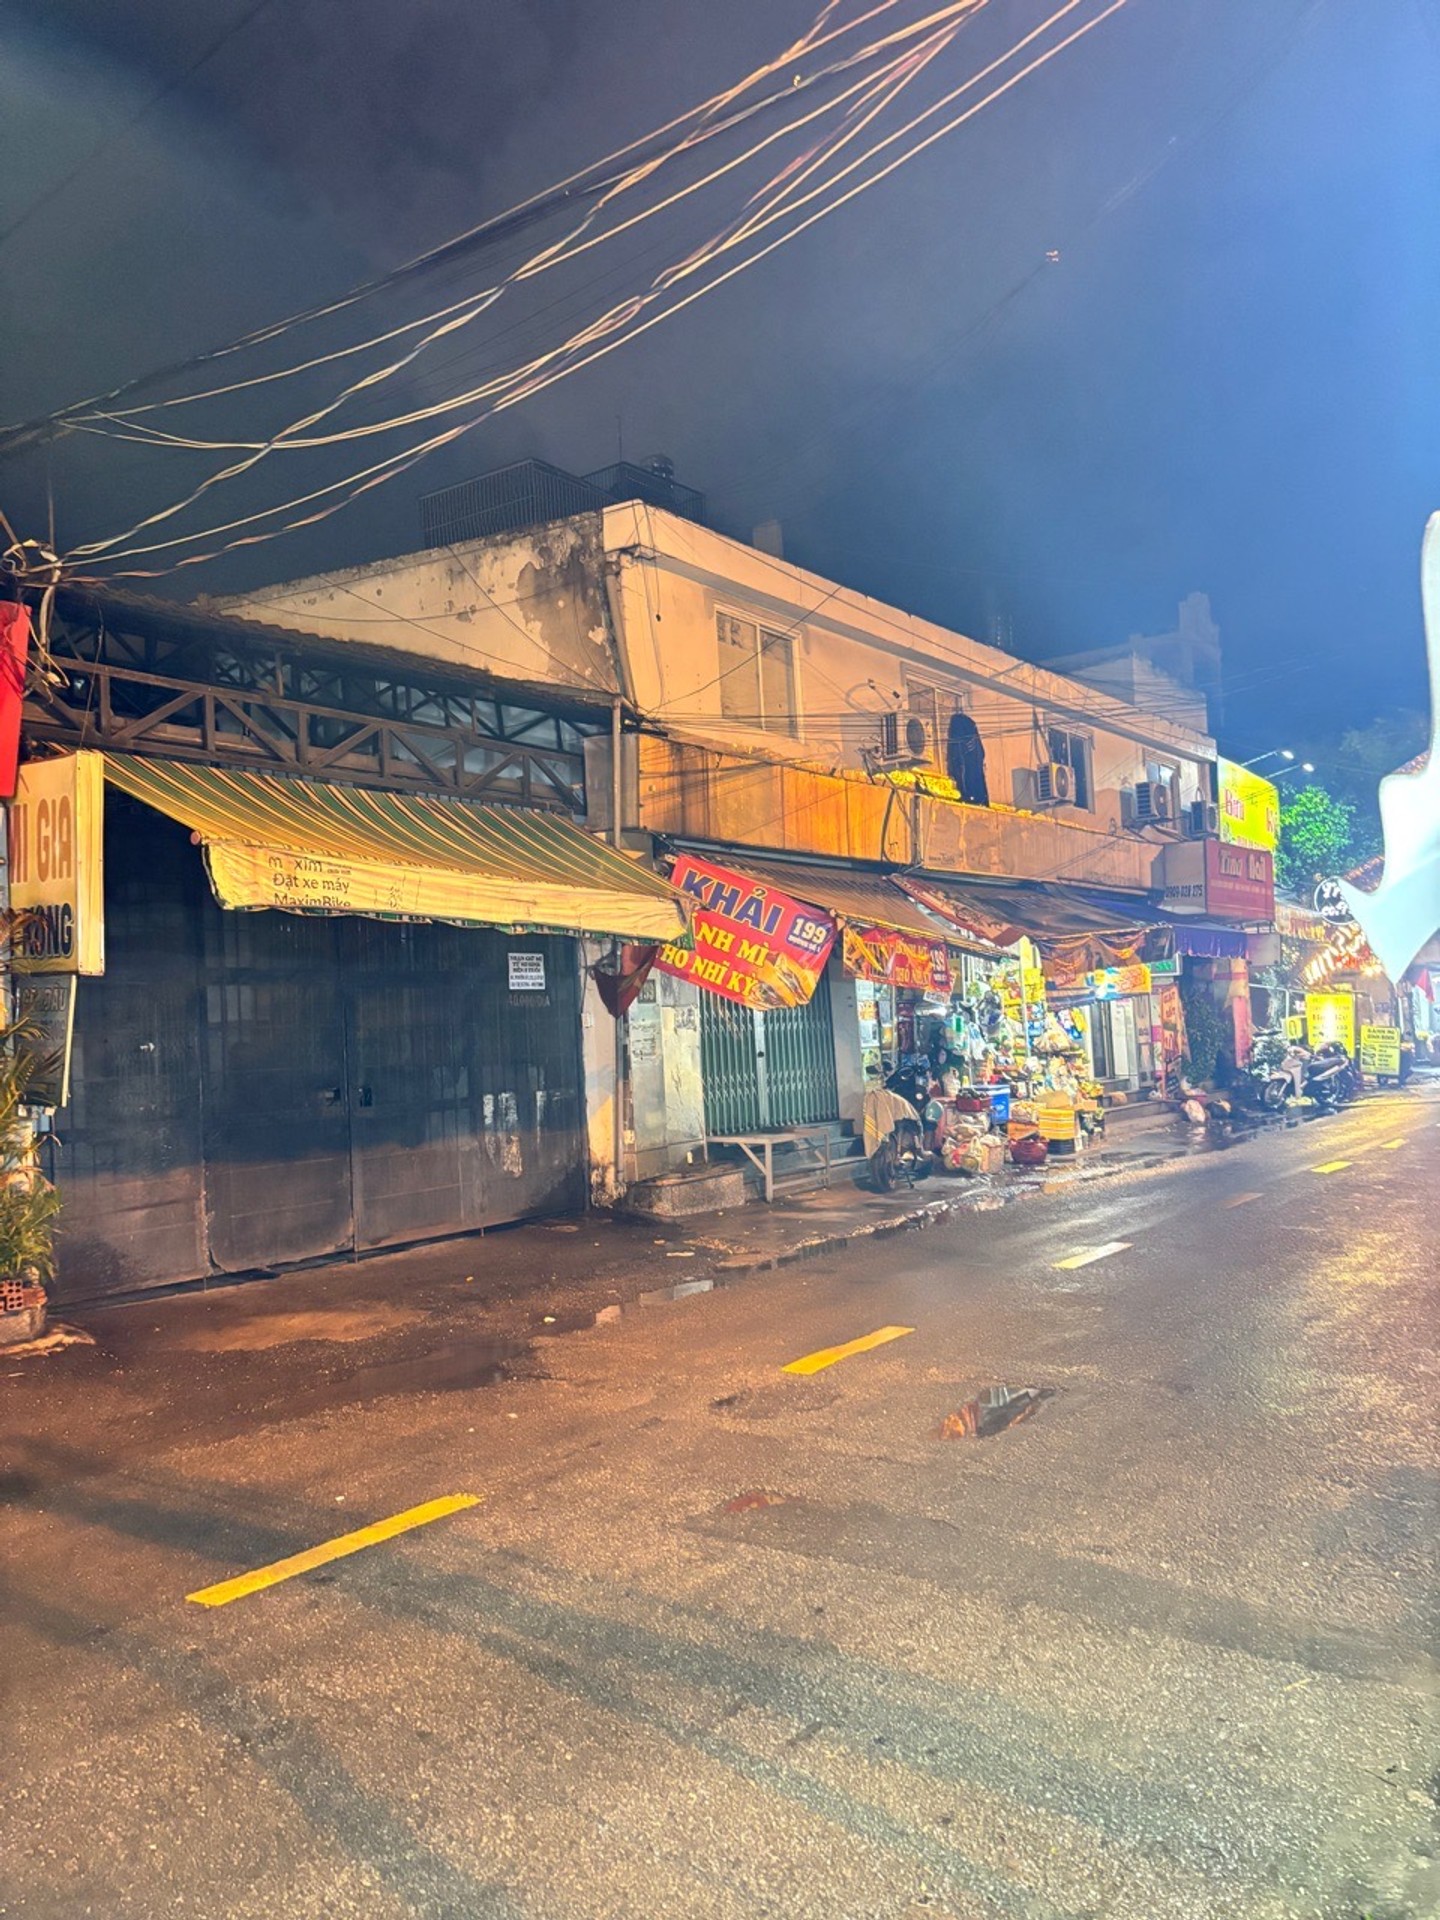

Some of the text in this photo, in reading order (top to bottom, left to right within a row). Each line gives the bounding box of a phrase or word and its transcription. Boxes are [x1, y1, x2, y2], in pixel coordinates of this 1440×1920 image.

[37, 796, 72, 881] GIA
[268, 855, 323, 873] mxim
[272, 872, 351, 895] Đặt xe máy
[682, 868, 785, 936] KHẢI
[696, 921, 770, 968] NH MÌ
[793, 917, 828, 944] 199
[690, 957, 728, 986] NHĨ
[726, 970, 759, 997] KỲ
